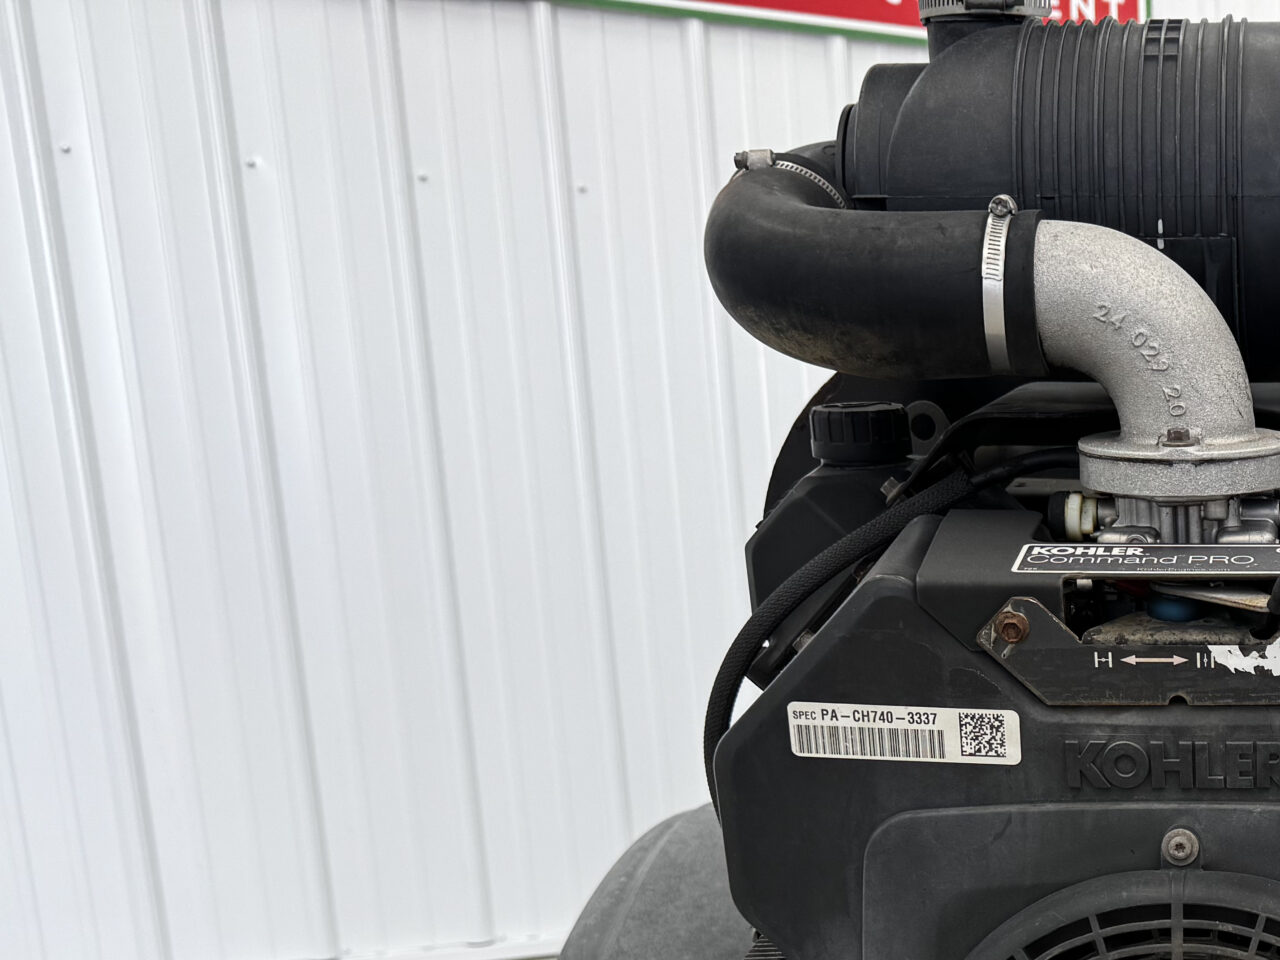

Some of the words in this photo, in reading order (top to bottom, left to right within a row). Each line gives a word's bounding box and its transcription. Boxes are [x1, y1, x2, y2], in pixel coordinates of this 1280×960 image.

[1093, 304, 1127, 331] 24
[1162, 384, 1187, 417] 20
[1031, 546, 1145, 556] KOHLER
[1027, 554, 1178, 564] Command
[1187, 555, 1255, 565] PRO
[792, 710, 817, 721] SPEC
[820, 708, 938, 725] PA-CH740-3337
